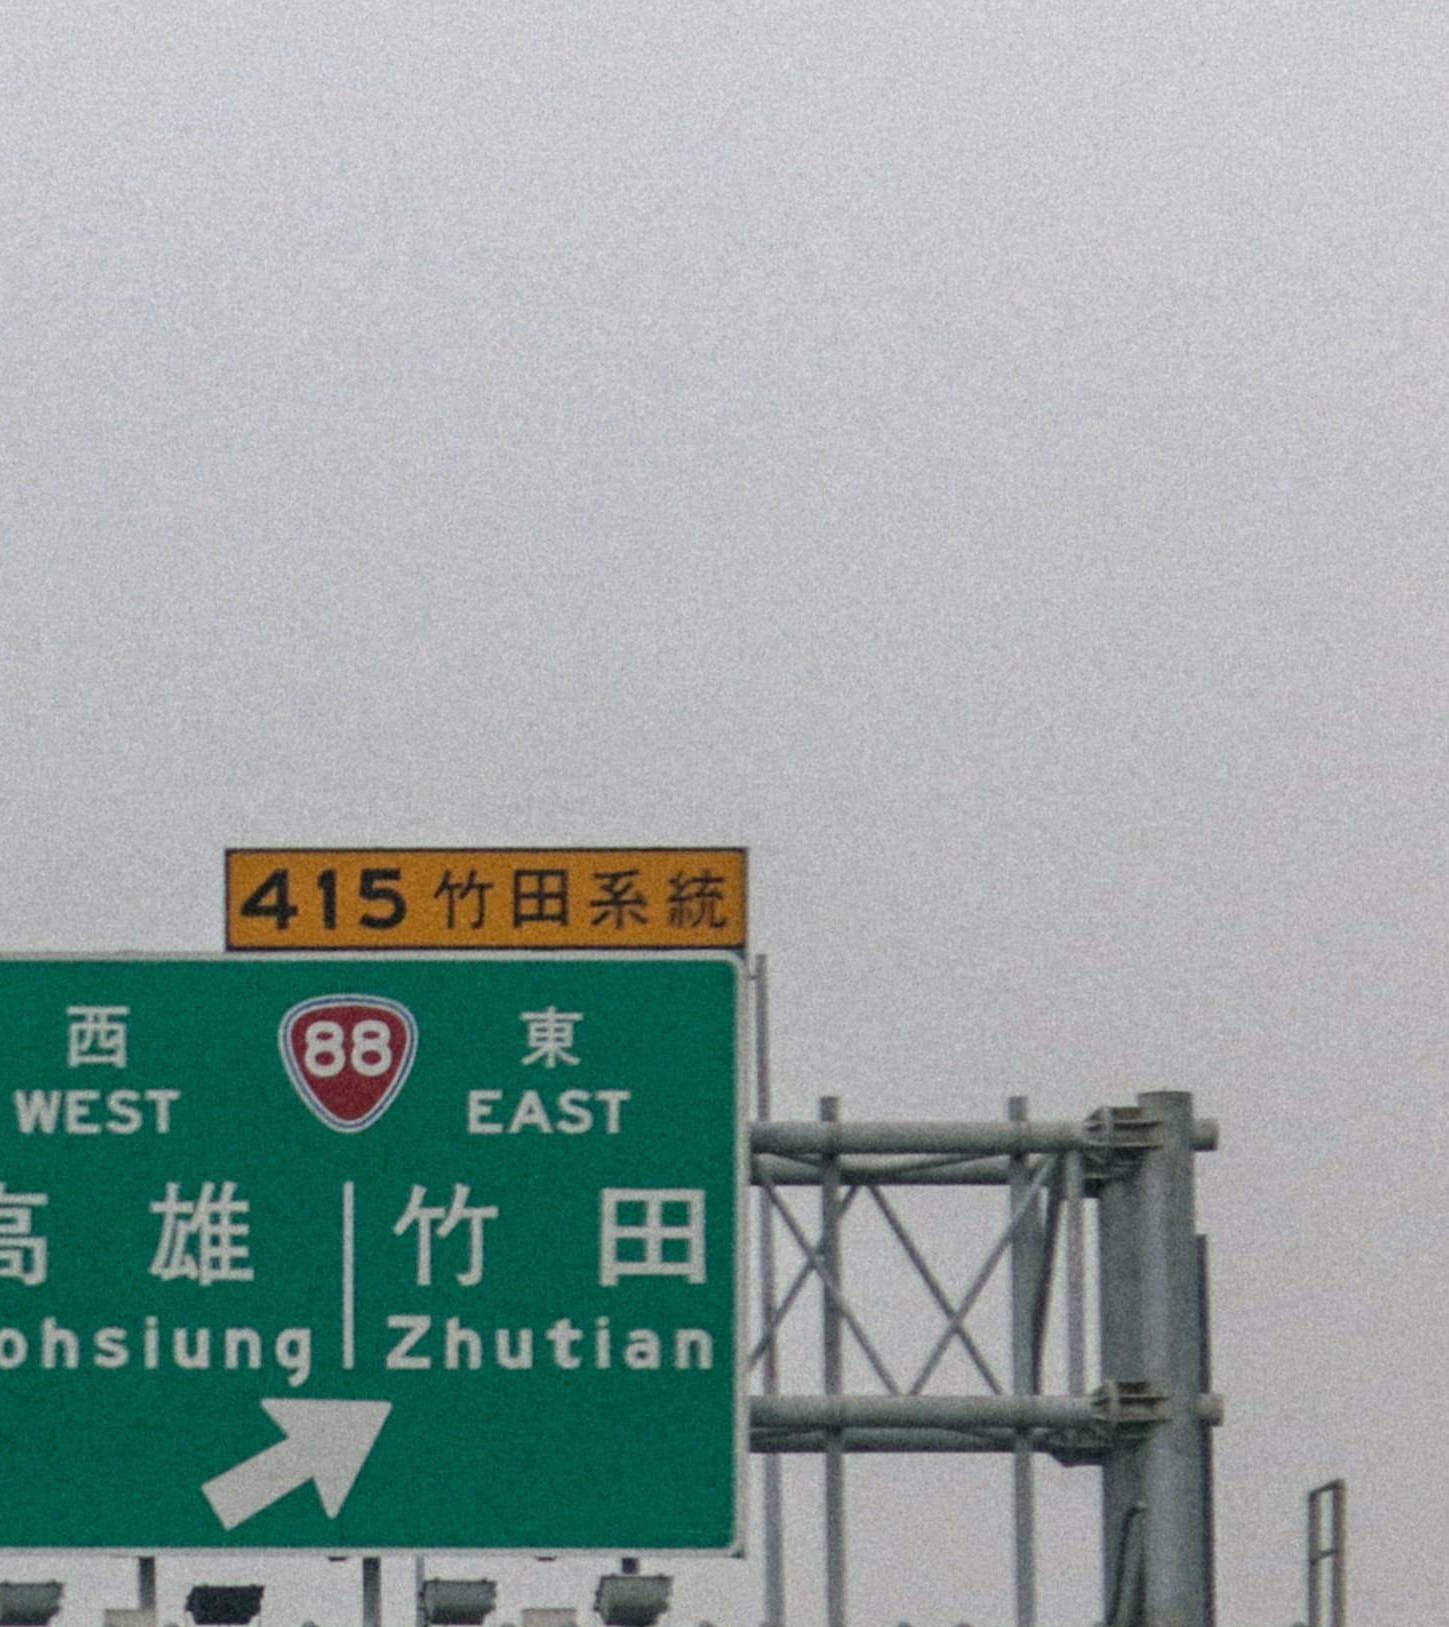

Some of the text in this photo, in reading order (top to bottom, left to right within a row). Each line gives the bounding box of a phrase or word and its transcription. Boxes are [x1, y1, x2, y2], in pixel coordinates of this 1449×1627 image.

[239, 867, 729, 932] 415 竹田系統
[65, 1005, 131, 1069] 西
[303, 1019, 394, 1078] 88
[520, 1006, 584, 1069] 東
[14, 1089, 181, 1135] WEST
[467, 1089, 632, 1135] EAST
[392, 1183, 708, 1287] 竹田
[385, 1313, 715, 1371] Zhutian
